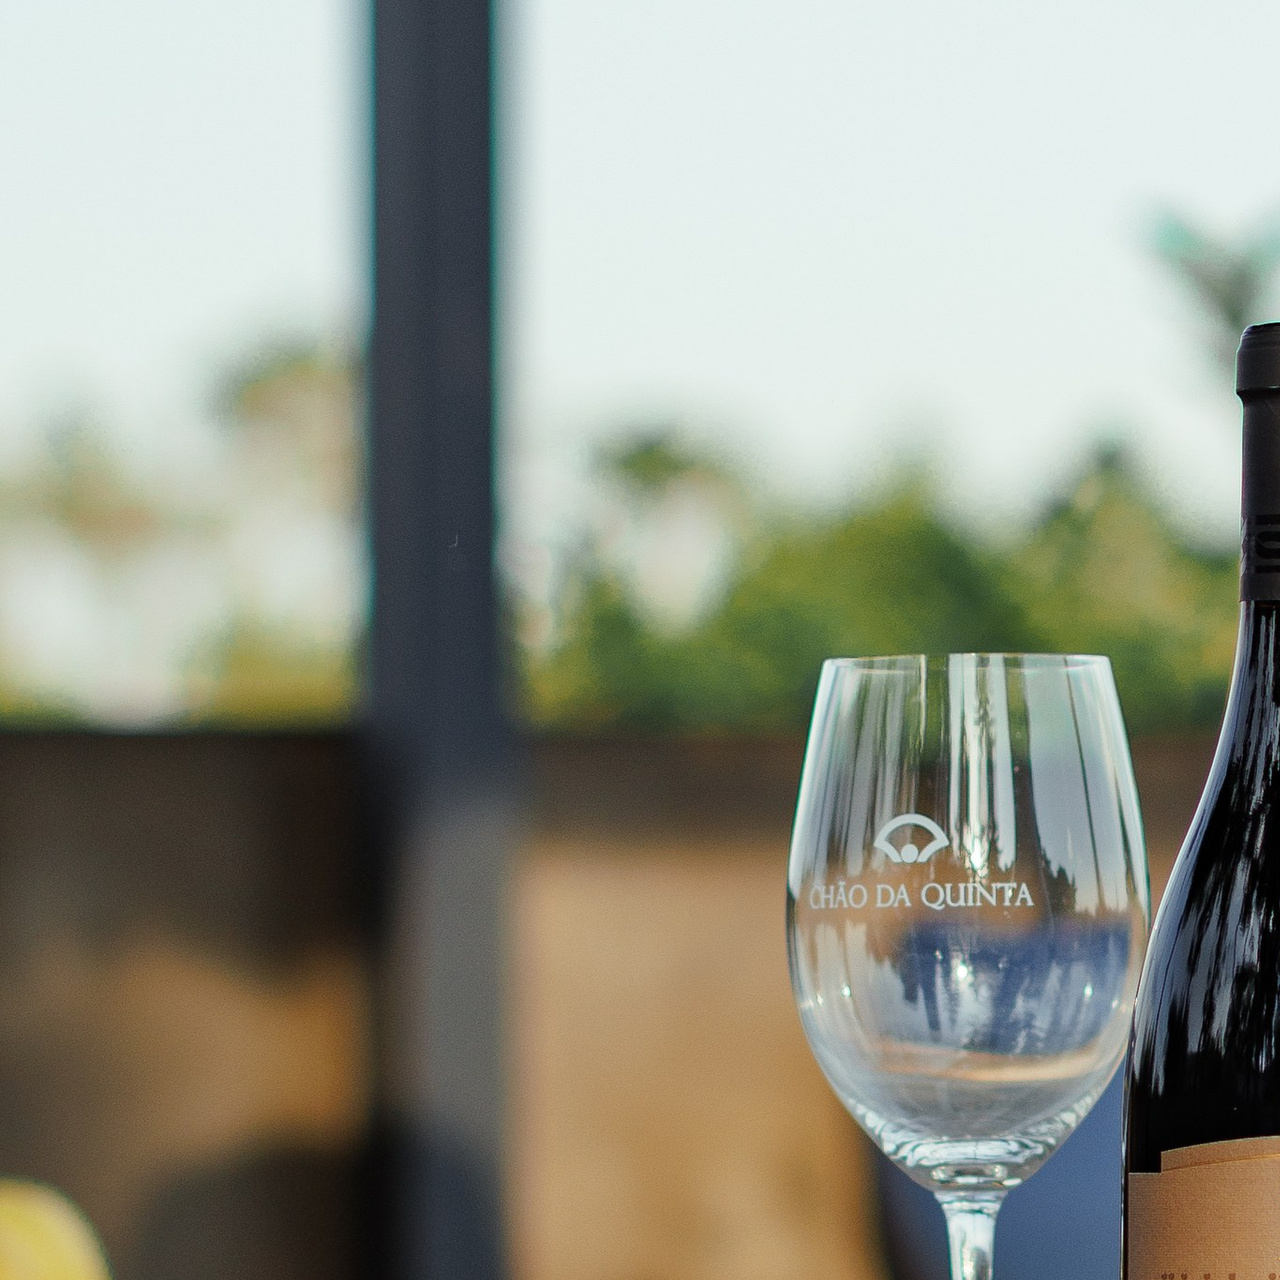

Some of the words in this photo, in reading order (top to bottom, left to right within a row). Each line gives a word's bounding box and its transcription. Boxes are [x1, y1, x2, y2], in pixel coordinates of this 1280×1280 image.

[809, 881, 868, 909] CHÃO
[875, 884, 912, 908] DA
[920, 882, 1035, 910] QUINTA
